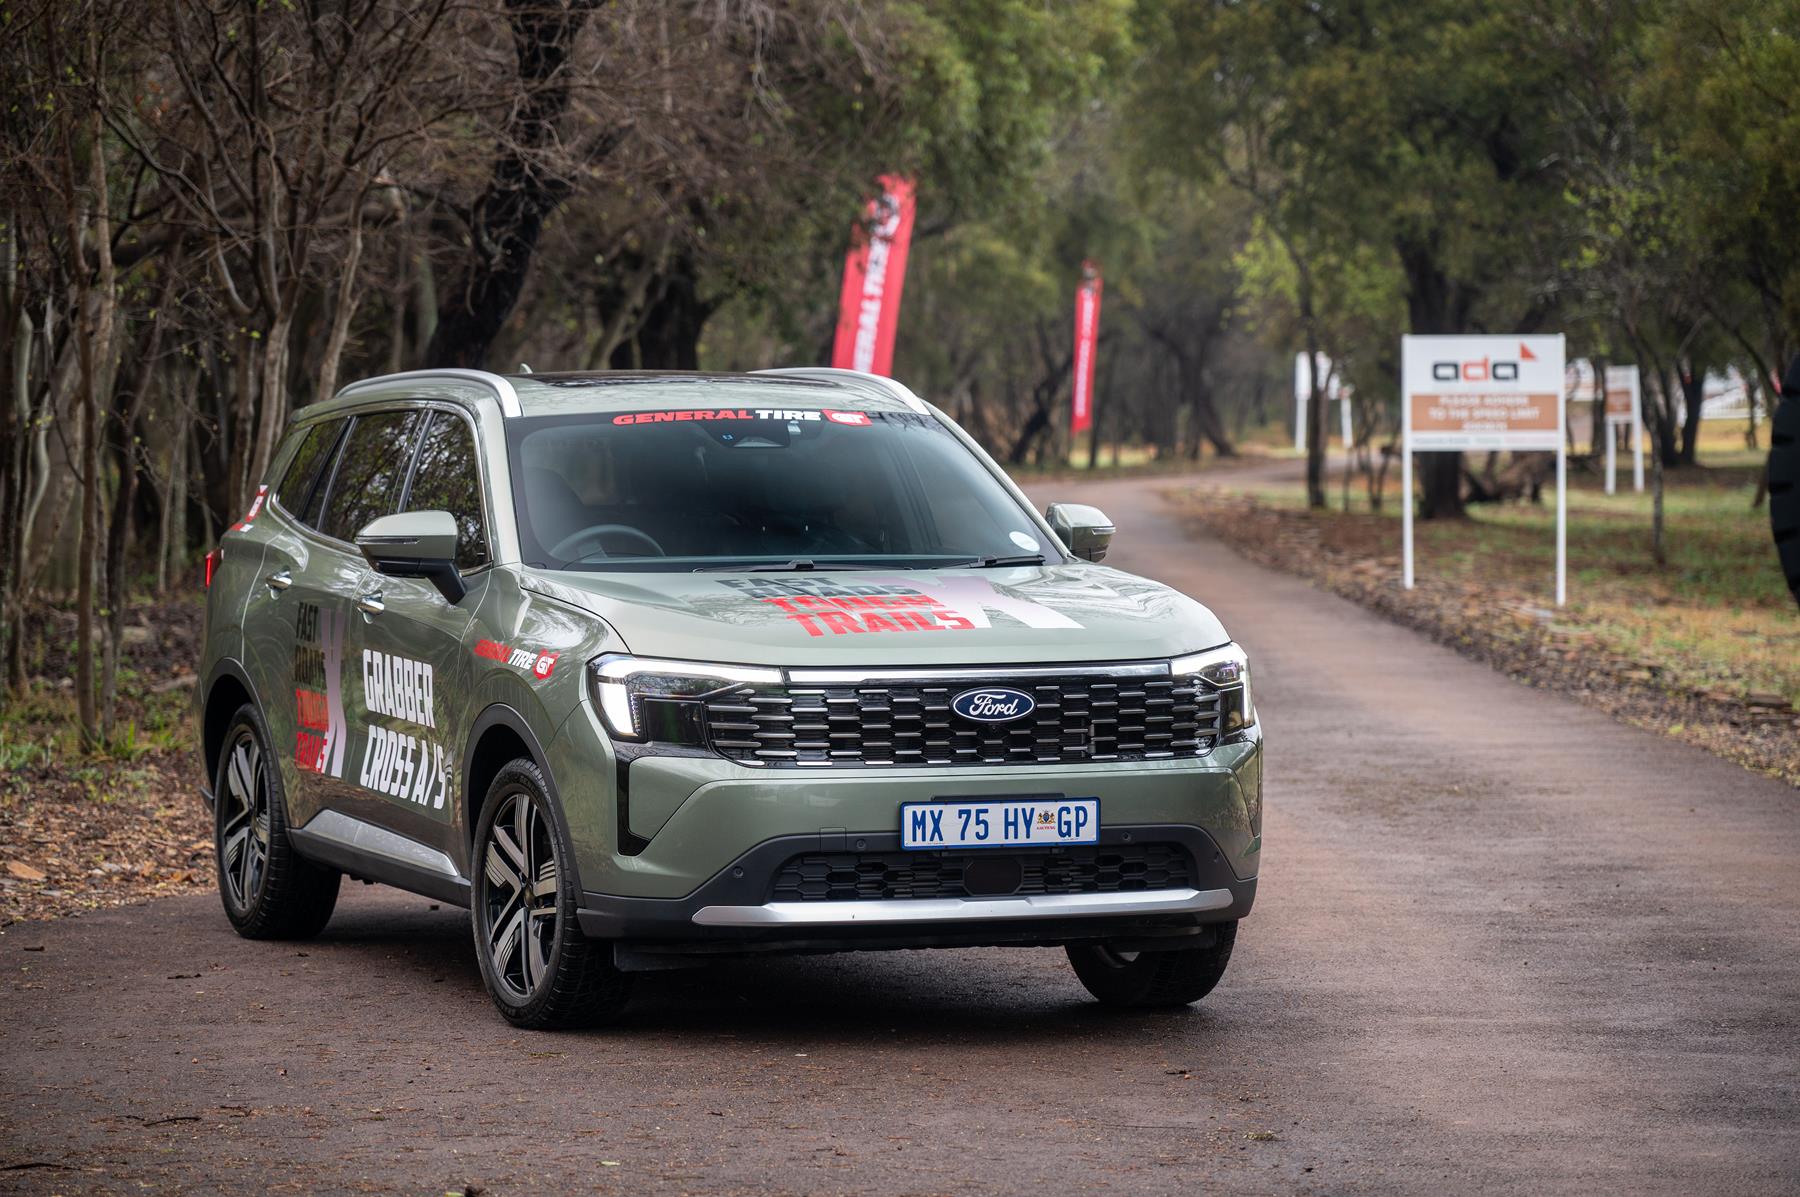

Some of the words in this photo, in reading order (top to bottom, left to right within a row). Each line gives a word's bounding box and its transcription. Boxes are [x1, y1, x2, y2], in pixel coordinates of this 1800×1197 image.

[1432, 355, 1519, 382] ada
[612, 409, 753, 425] GENERAL
[755, 409, 821, 421] TIRE
[715, 577, 838, 588] FAST
[296, 602, 318, 643] FAST
[786, 611, 976, 637] TRAILS
[508, 648, 538, 670] TIRE
[363, 649, 435, 729] GRABBER
[969, 693, 1019, 716] Ford
[360, 725, 416, 799] CROSS
[411, 740, 446, 809] A/S
[912, 810, 943, 842] MX
[958, 808, 989, 841] 75
[1004, 807, 1035, 840] HY
[1058, 806, 1088, 838] GP
